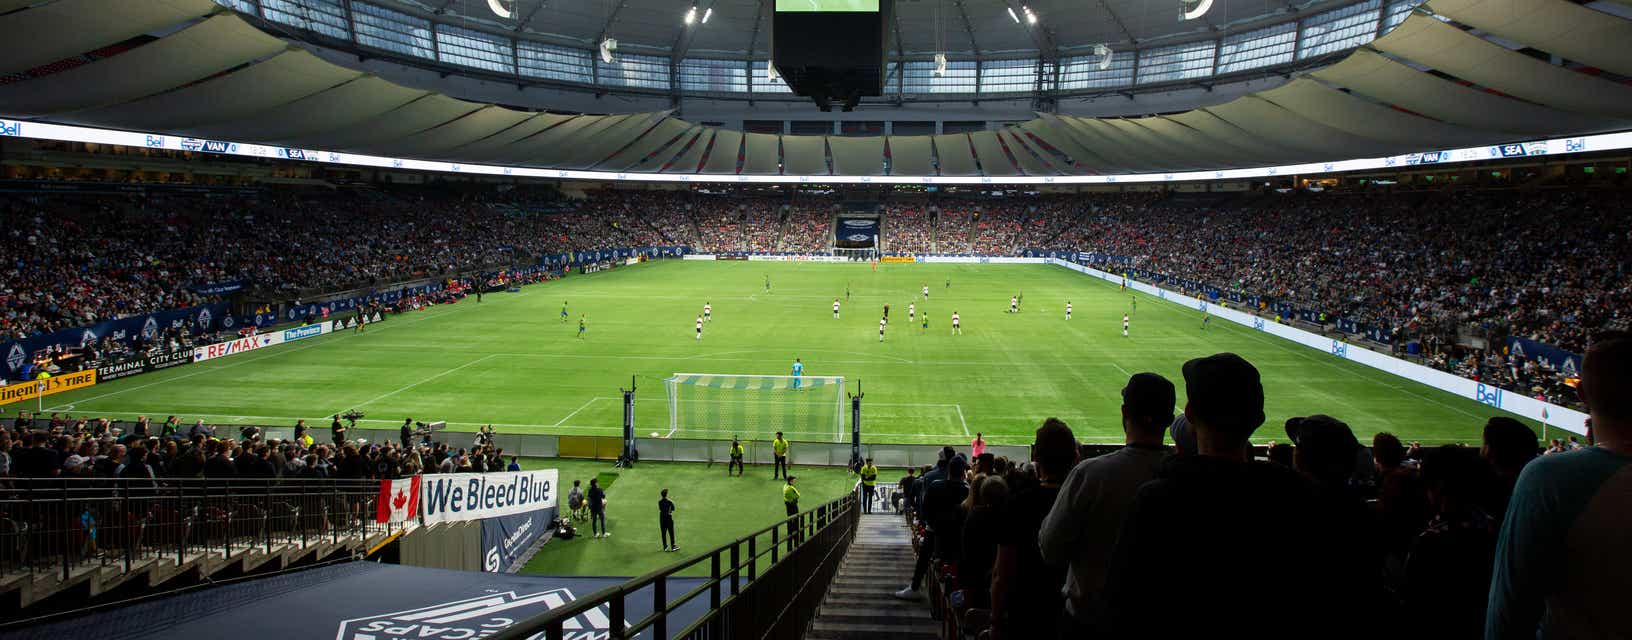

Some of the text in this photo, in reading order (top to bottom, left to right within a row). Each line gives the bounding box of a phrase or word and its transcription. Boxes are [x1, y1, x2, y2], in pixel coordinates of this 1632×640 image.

[0, 121, 21, 137] Bell
[146, 135, 165, 147] Bell
[206, 142, 225, 151] VAN
[1566, 140, 1584, 151] Bell
[289, 149, 303, 158] SEA
[1503, 144, 1522, 155] SEA
[1423, 153, 1439, 162] VAN
[207, 336, 260, 358] RE/MAX
[1332, 340, 1348, 357] Bell
[98, 360, 145, 376] TERMINAL
[150, 354, 170, 365] CITY
[172, 350, 193, 360] CLUB
[65, 373, 92, 387] TIRE
[1476, 383, 1503, 409] Bell
[427, 473, 550, 515] We Bleed Blue
